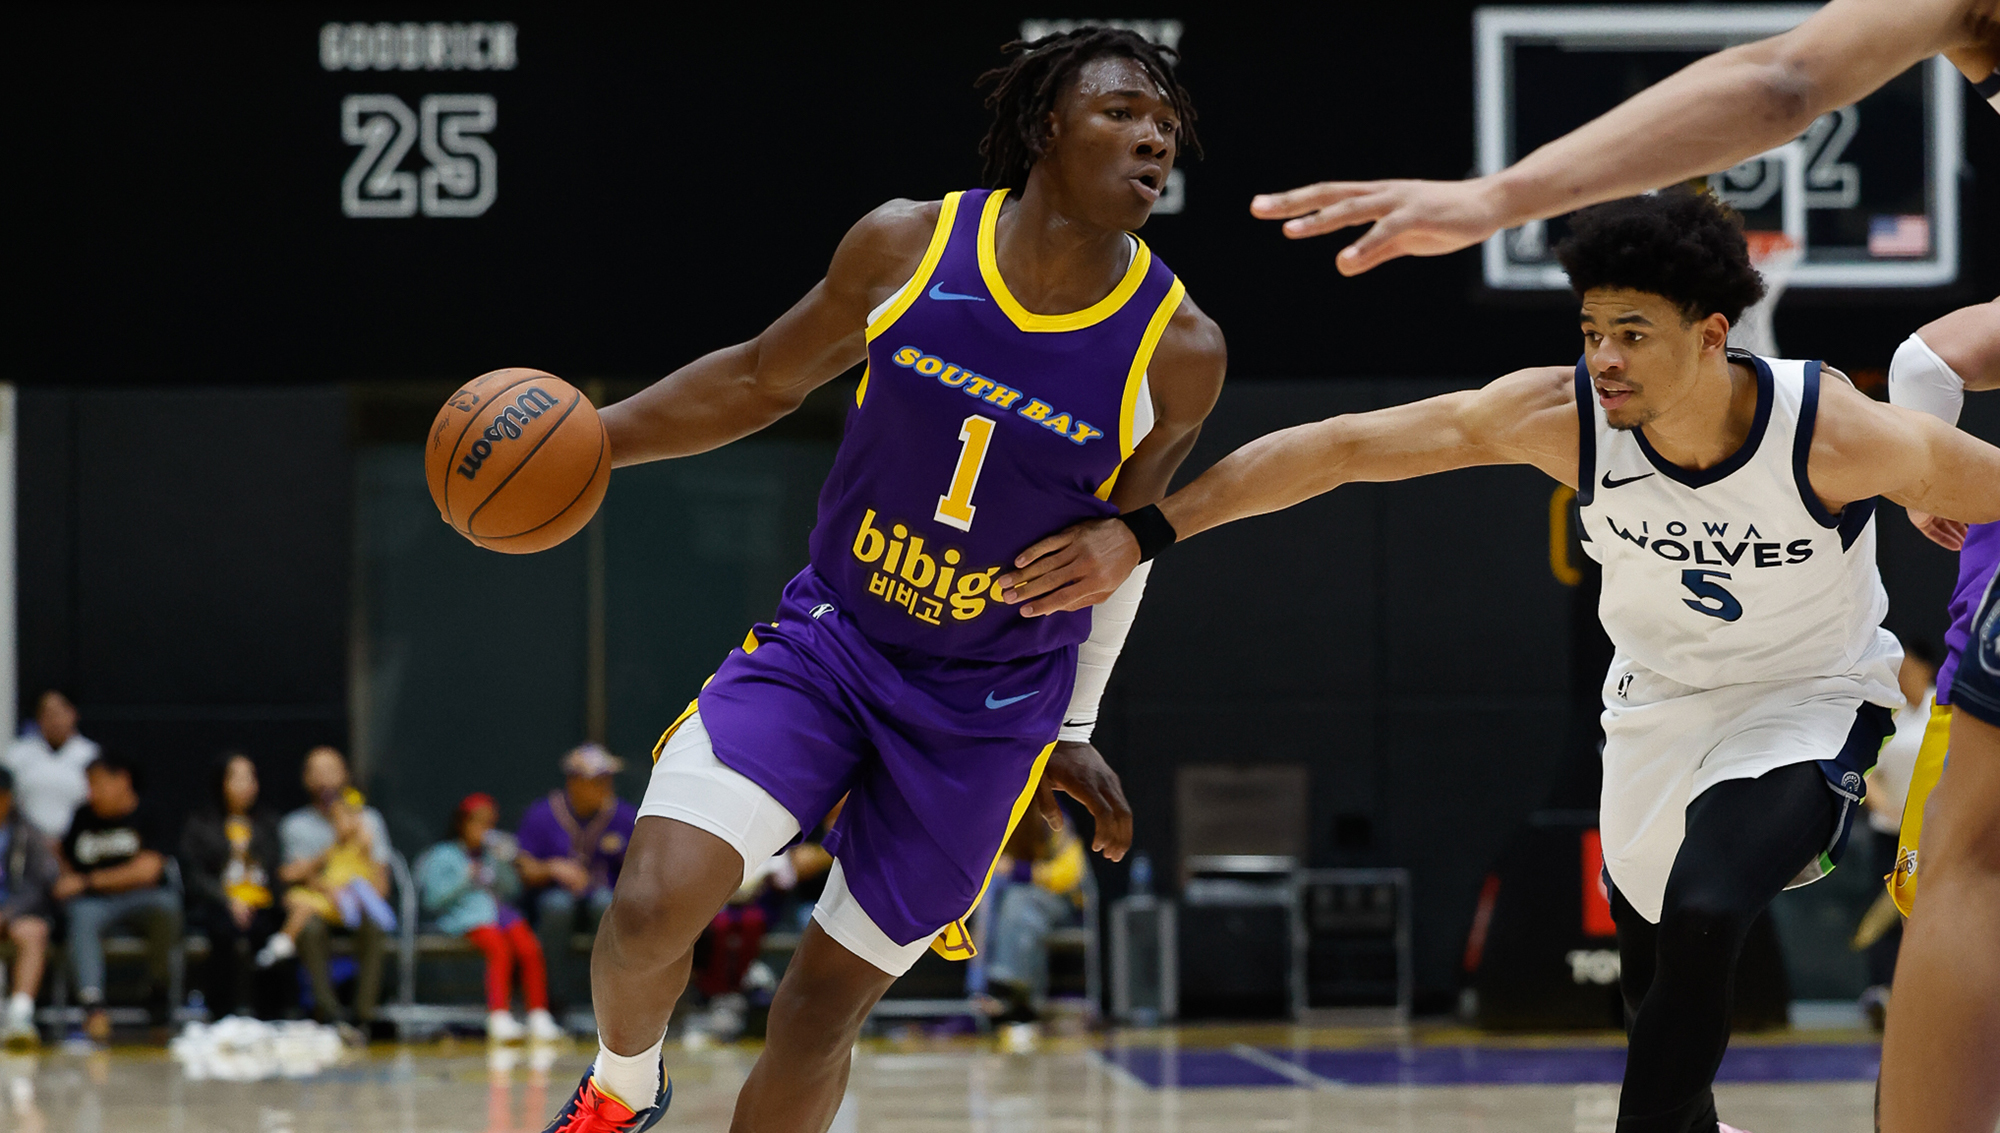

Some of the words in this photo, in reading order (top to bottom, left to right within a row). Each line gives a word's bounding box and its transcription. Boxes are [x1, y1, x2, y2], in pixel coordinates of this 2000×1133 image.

[341, 93, 498, 218] 25
[892, 345, 1023, 410] SOUTH
[1017, 398, 1104, 445] BAY
[457, 386, 560, 481] Wilson
[933, 414, 997, 532] 1
[1605, 515, 1814, 568] WOLVES
[1642, 520, 1762, 540] IOWA
[868, 571, 944, 626] 비비고
[1681, 569, 1743, 622] 5
